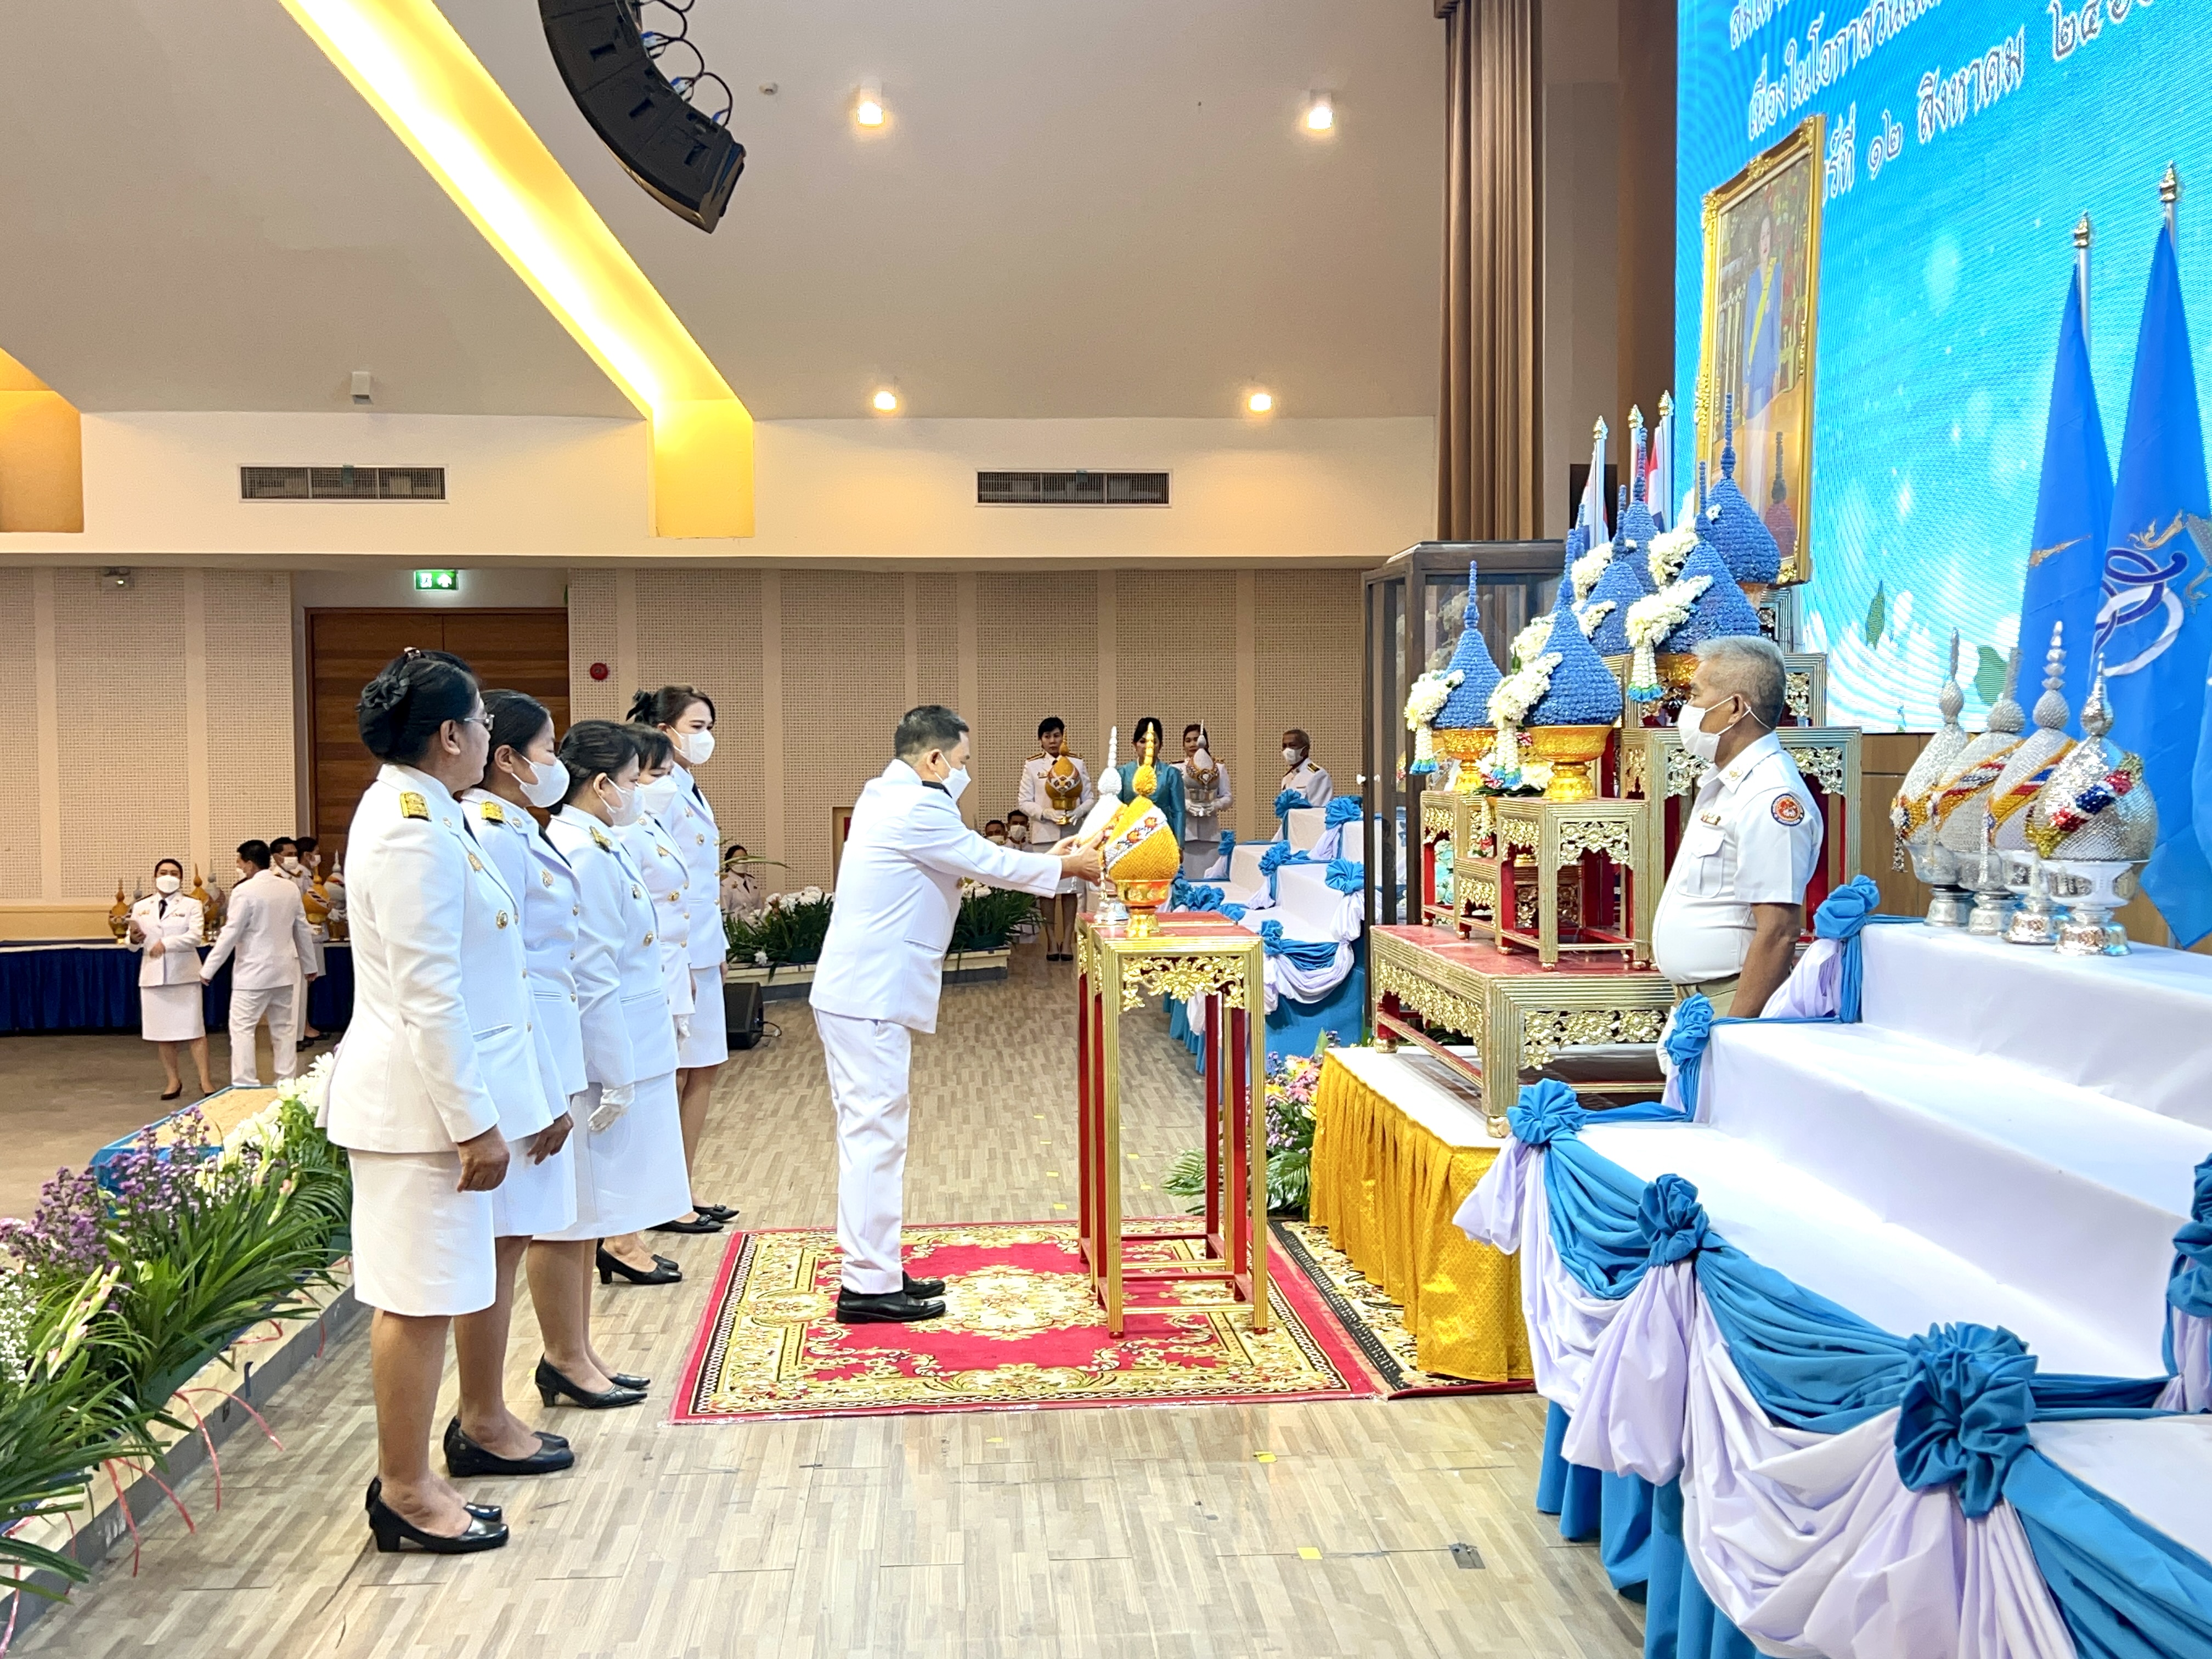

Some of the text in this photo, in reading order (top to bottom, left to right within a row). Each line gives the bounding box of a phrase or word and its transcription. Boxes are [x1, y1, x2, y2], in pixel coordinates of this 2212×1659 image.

[1822, 0, 2153, 207] ร์ที่ ๑๒ สิงหาคม ๒๕
